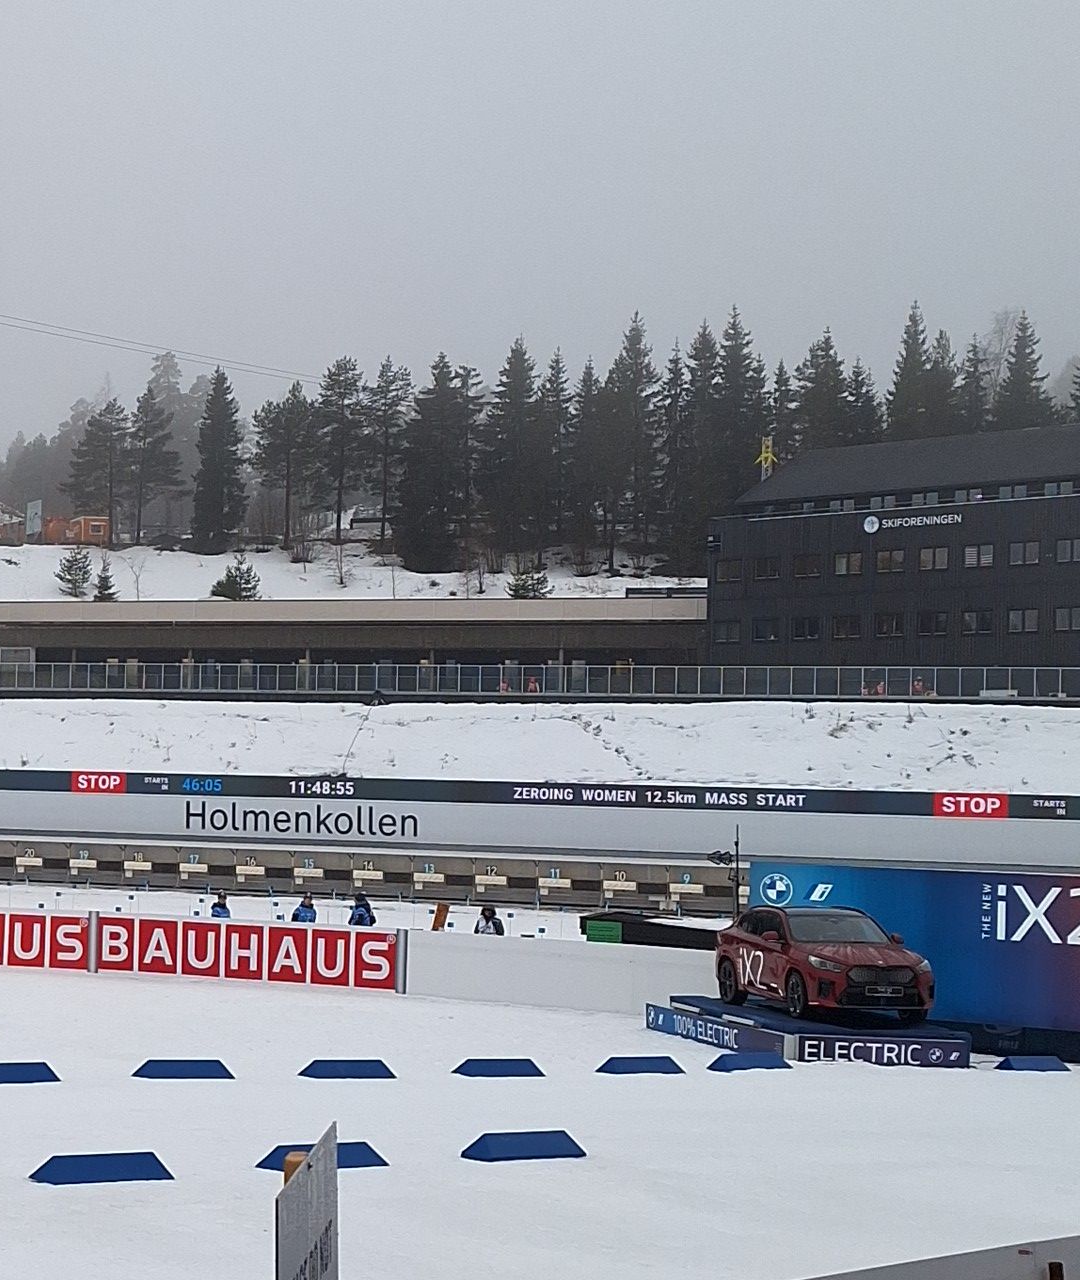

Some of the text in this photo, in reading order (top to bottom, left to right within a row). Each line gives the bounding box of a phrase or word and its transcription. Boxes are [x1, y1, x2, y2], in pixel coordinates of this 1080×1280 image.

[881, 513, 962, 529] SKIFORENINGEN
[77, 775, 121, 790] STOP
[182, 778, 223, 792] 46:05
[288, 780, 355, 796] 11:48:55
[513, 787, 807, 807] ZEROING WOMEN 12.5km MASS START
[942, 796, 1001, 814] STOP
[1032, 799, 1066, 808] STARTS
[185, 800, 419, 838] Holmenkollen
[25, 848, 35, 857] 20
[79, 850, 88, 859] 19
[134, 852, 143, 861] 18
[189, 854, 199, 863] 17
[246, 857, 256, 866] 16
[304, 859, 314, 868] 15
[363, 861, 374, 870] 14
[424, 863, 435, 873] 13
[486, 865, 497, 875] 12
[550, 868, 560, 878] 11
[614, 871, 626, 881] 10
[683, 873, 690, 884] 9
[981, 883, 992, 940] THE NEW
[101, 924, 391, 981] BAUHAUS
[739, 947, 767, 990] iX2
[673, 1014, 739, 1049] 100% ELECTRIC
[804, 1040, 922, 1064] ELECTRIC
